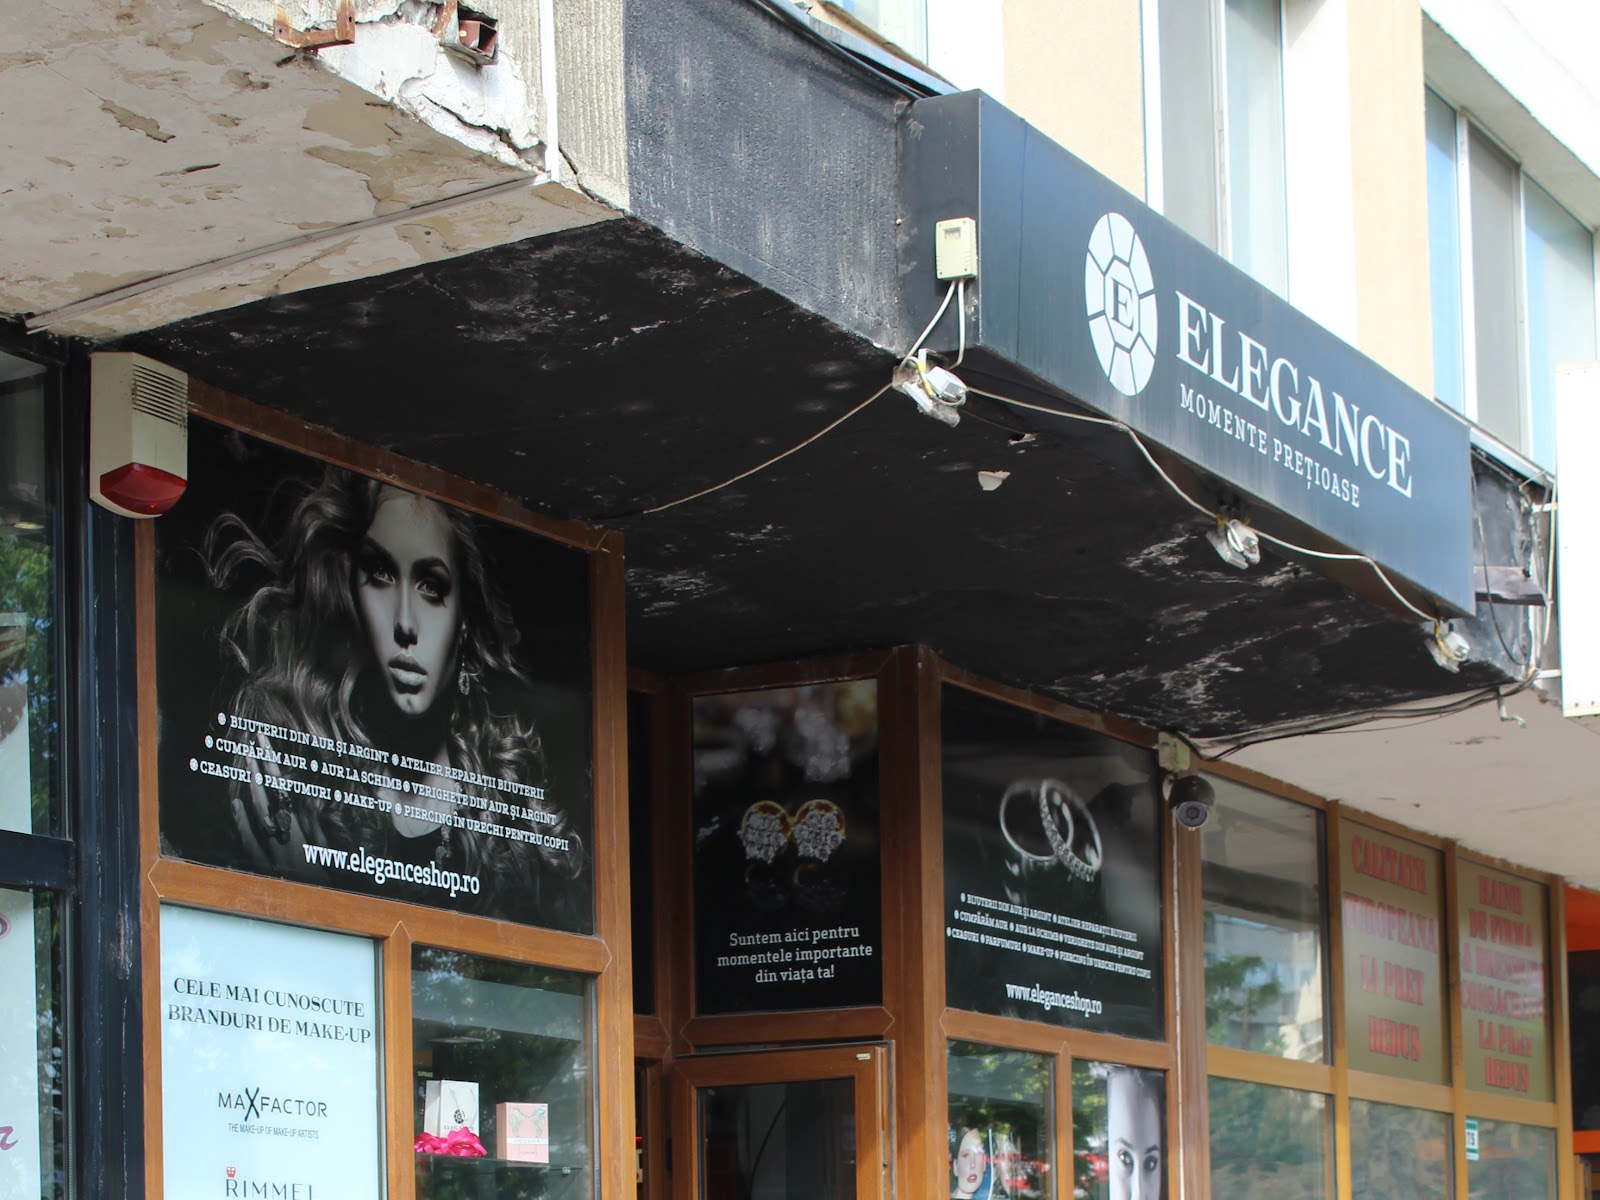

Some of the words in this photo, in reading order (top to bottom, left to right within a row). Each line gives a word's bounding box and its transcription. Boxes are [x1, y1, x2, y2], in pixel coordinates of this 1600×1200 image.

[1109, 275, 1135, 332] E
[1175, 290, 1413, 498] ELEGANCE
[1180, 383, 1267, 456] MOMENTE
[1273, 438, 1360, 508] PREȚIOASE
[215, 737, 282, 765] CUMPĂRĂM
[283, 754, 307, 771] AUR
[321, 762, 346, 779] AUR
[346, 770, 360, 782] LA
[360, 772, 402, 791] SCHIMB
[411, 782, 469, 807] VERIGHETE
[470, 795, 488, 811] DIN
[488, 800, 510, 816] AUR
[521, 810, 556, 826] ARGINT
[230, 714, 288, 740] BIJUTERII
[289, 729, 310, 747] DIN
[311, 735, 335, 751] AUR
[348, 744, 389, 764] ARGINT
[400, 755, 444, 776] ATELIER
[497, 778, 545, 800] BIJUTERII
[200, 760, 252, 783] CEASURI
[264, 774, 332, 801] PARFUMURI
[343, 791, 392, 813] MAKE-UP
[404, 805, 453, 826] PIERCING
[452, 812, 467, 829] ÎN
[467, 819, 504, 838] URECHI
[505, 827, 542, 846] PENTRU
[543, 836, 569, 851] COPII
[302, 841, 480, 899] www.eleganceshop.ro
[717, 948, 792, 967] momentele
[795, 944, 873, 964] importante
[729, 932, 782, 947] Suntem
[784, 927, 810, 943] aici
[812, 926, 860, 944] pentru
[173, 977, 222, 999] CELE
[225, 984, 260, 1004] MAI
[263, 989, 365, 1017] CUNOSCUTE
[755, 969, 778, 983] din
[817, 964, 835, 979] ta!
[168, 1003, 264, 1031] BRANDURI
[268, 1016, 292, 1035] DE
[295, 1020, 371, 1044] MAKE-UP
[1005, 983, 1103, 1017] www.eleganceshop.ro
[228, 1122, 239, 1133] THE
[239, 1124, 264, 1135] MAKE-UP
[265, 1126, 272, 1136] OF
[273, 1127, 297, 1138] MAKE-UP
[297, 1129, 319, 1140] ARTISTS
